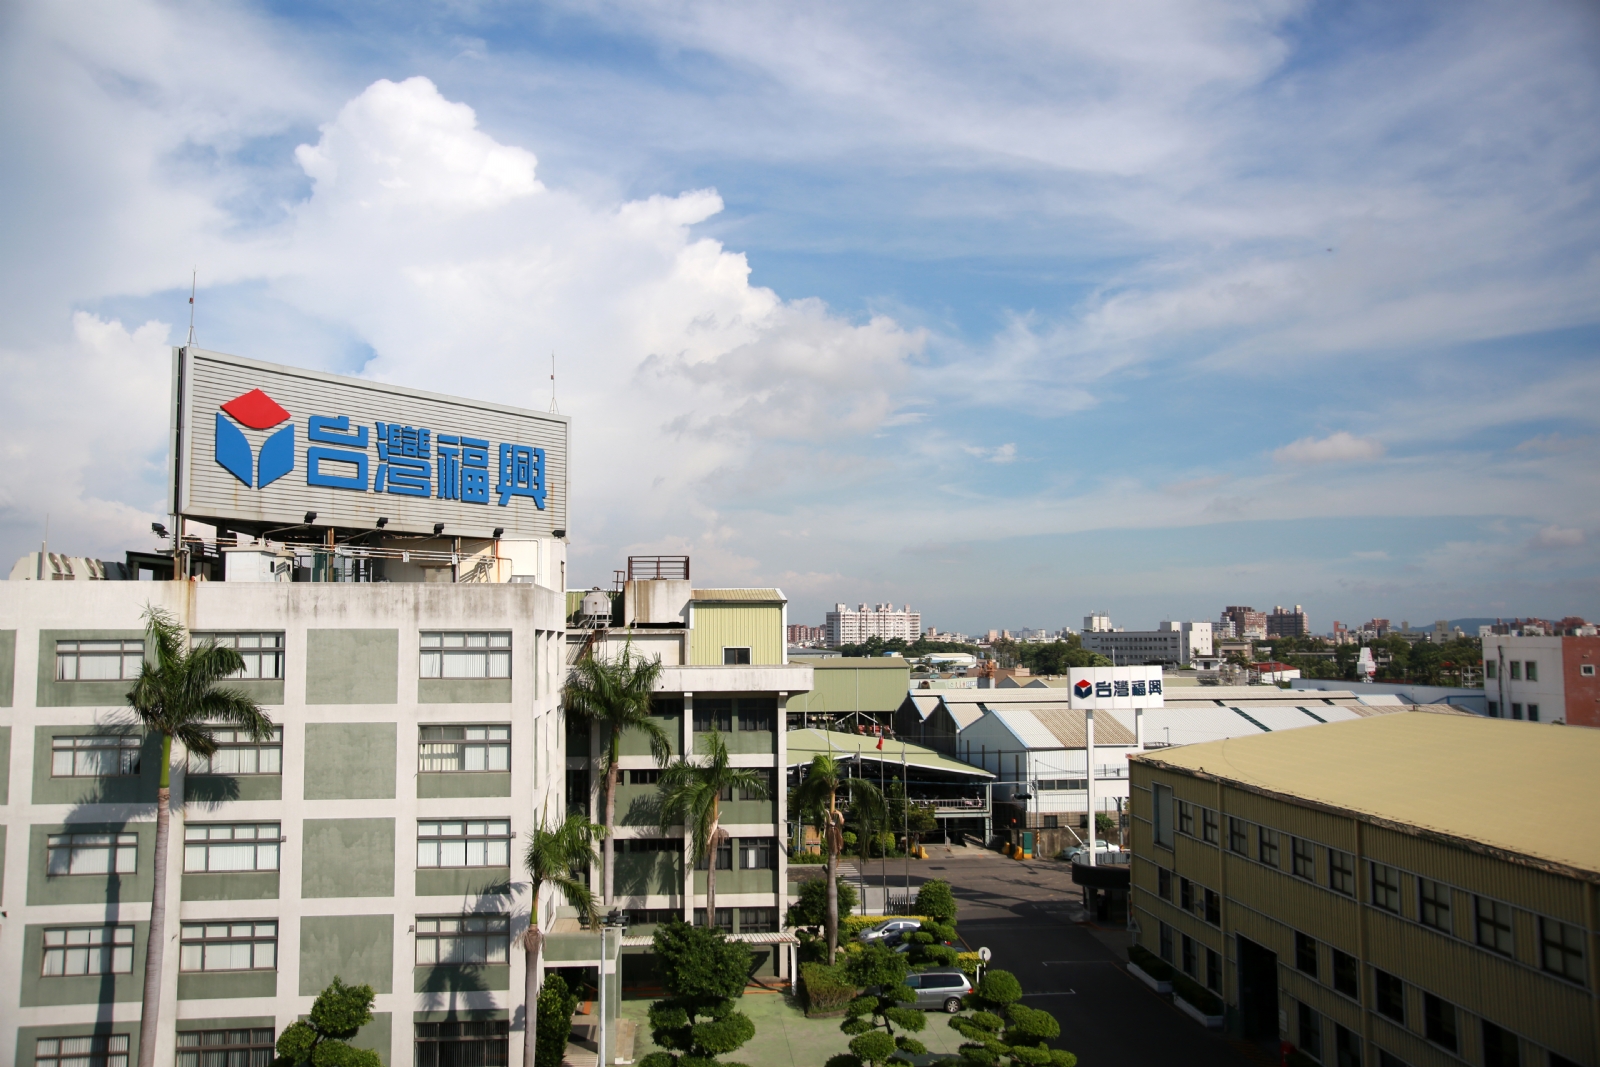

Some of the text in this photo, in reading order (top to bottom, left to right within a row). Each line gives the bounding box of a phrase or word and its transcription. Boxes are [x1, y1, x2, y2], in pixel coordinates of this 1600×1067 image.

[307, 415, 547, 510] 台灣福興
[1095, 679, 1162, 698] 台灣福興
